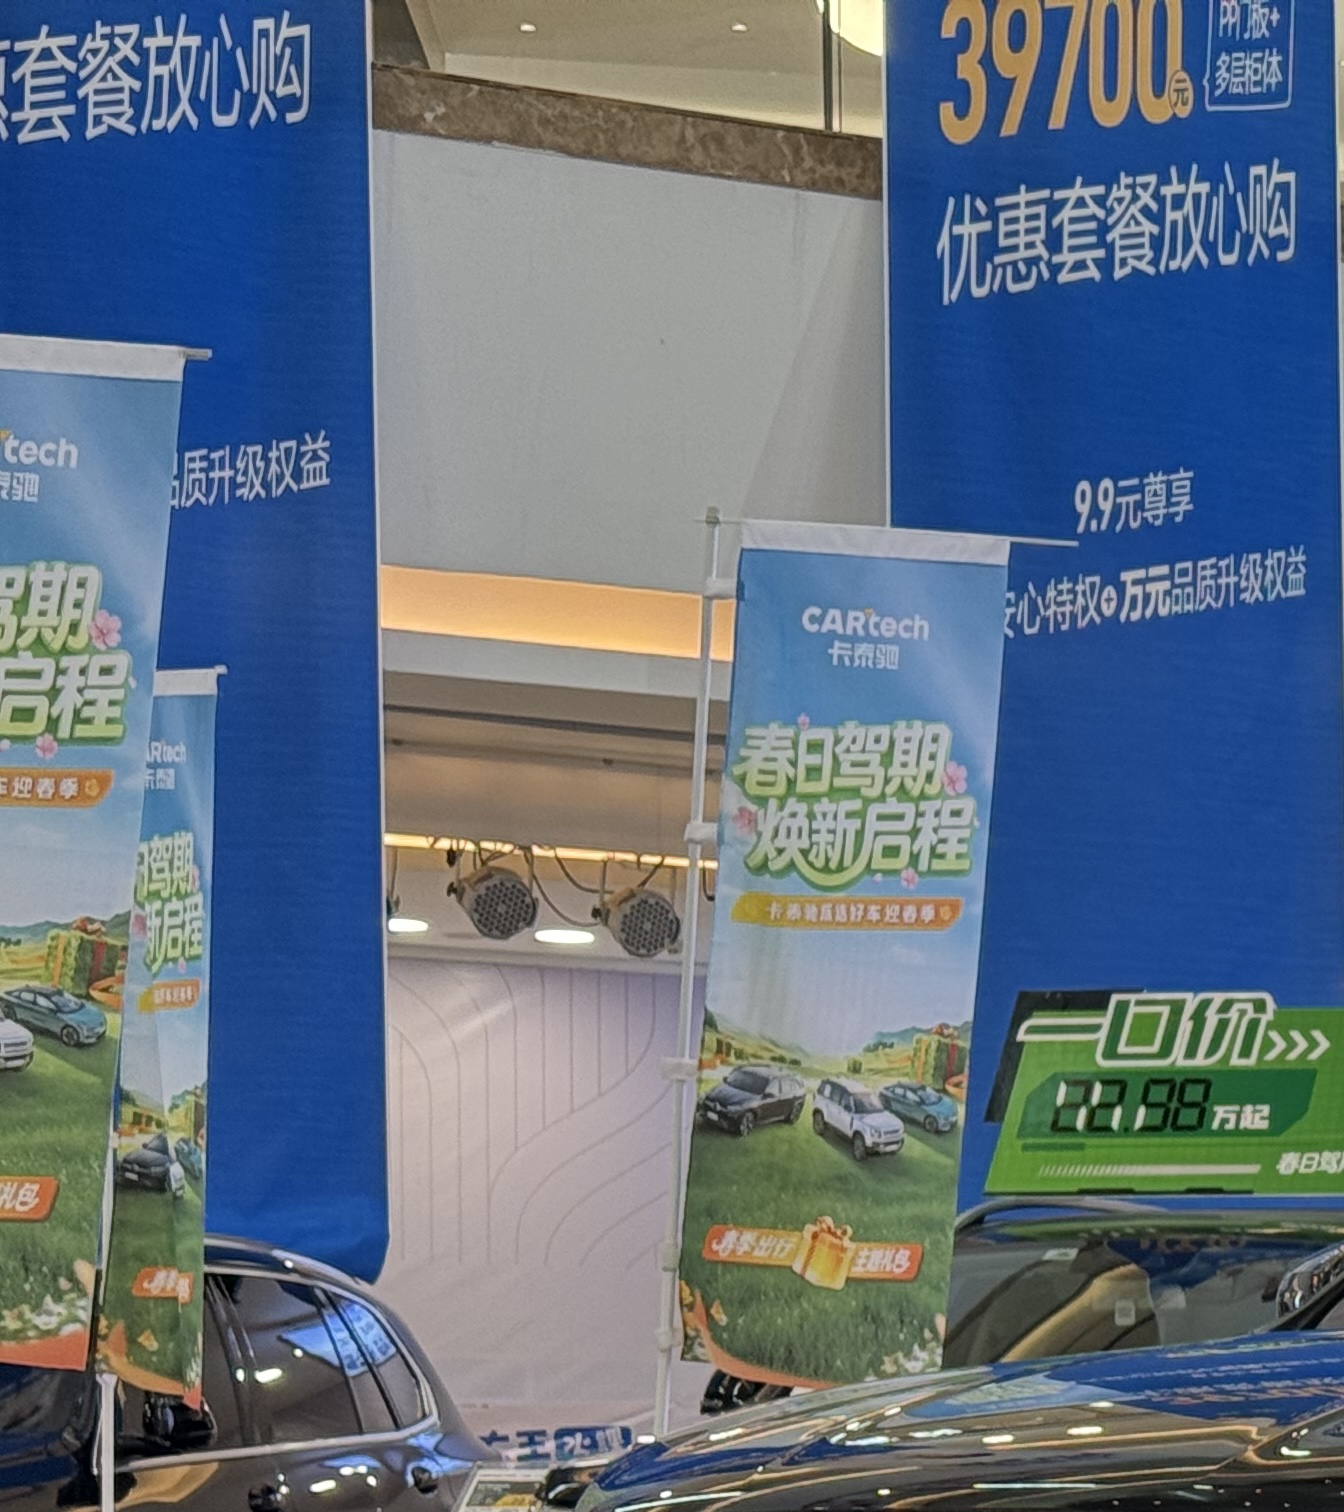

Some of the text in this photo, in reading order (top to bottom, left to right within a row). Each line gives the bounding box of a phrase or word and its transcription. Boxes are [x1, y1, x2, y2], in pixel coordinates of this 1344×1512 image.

[0, 10, 311, 145] 套餐放心购
[1214, 48, 1284, 97] 多层柜体
[937, 157, 1297, 306] 优惠套餐放心购
[1074, 466, 1194, 534] 9.9元尊享
[801, 605, 930, 641] CARtech
[828, 640, 900, 670] 卡泰驰
[733, 719, 950, 799] 春日驾期
[745, 797, 975, 887] 焕新启程
[1016, 991, 1276, 1068] 一口价
